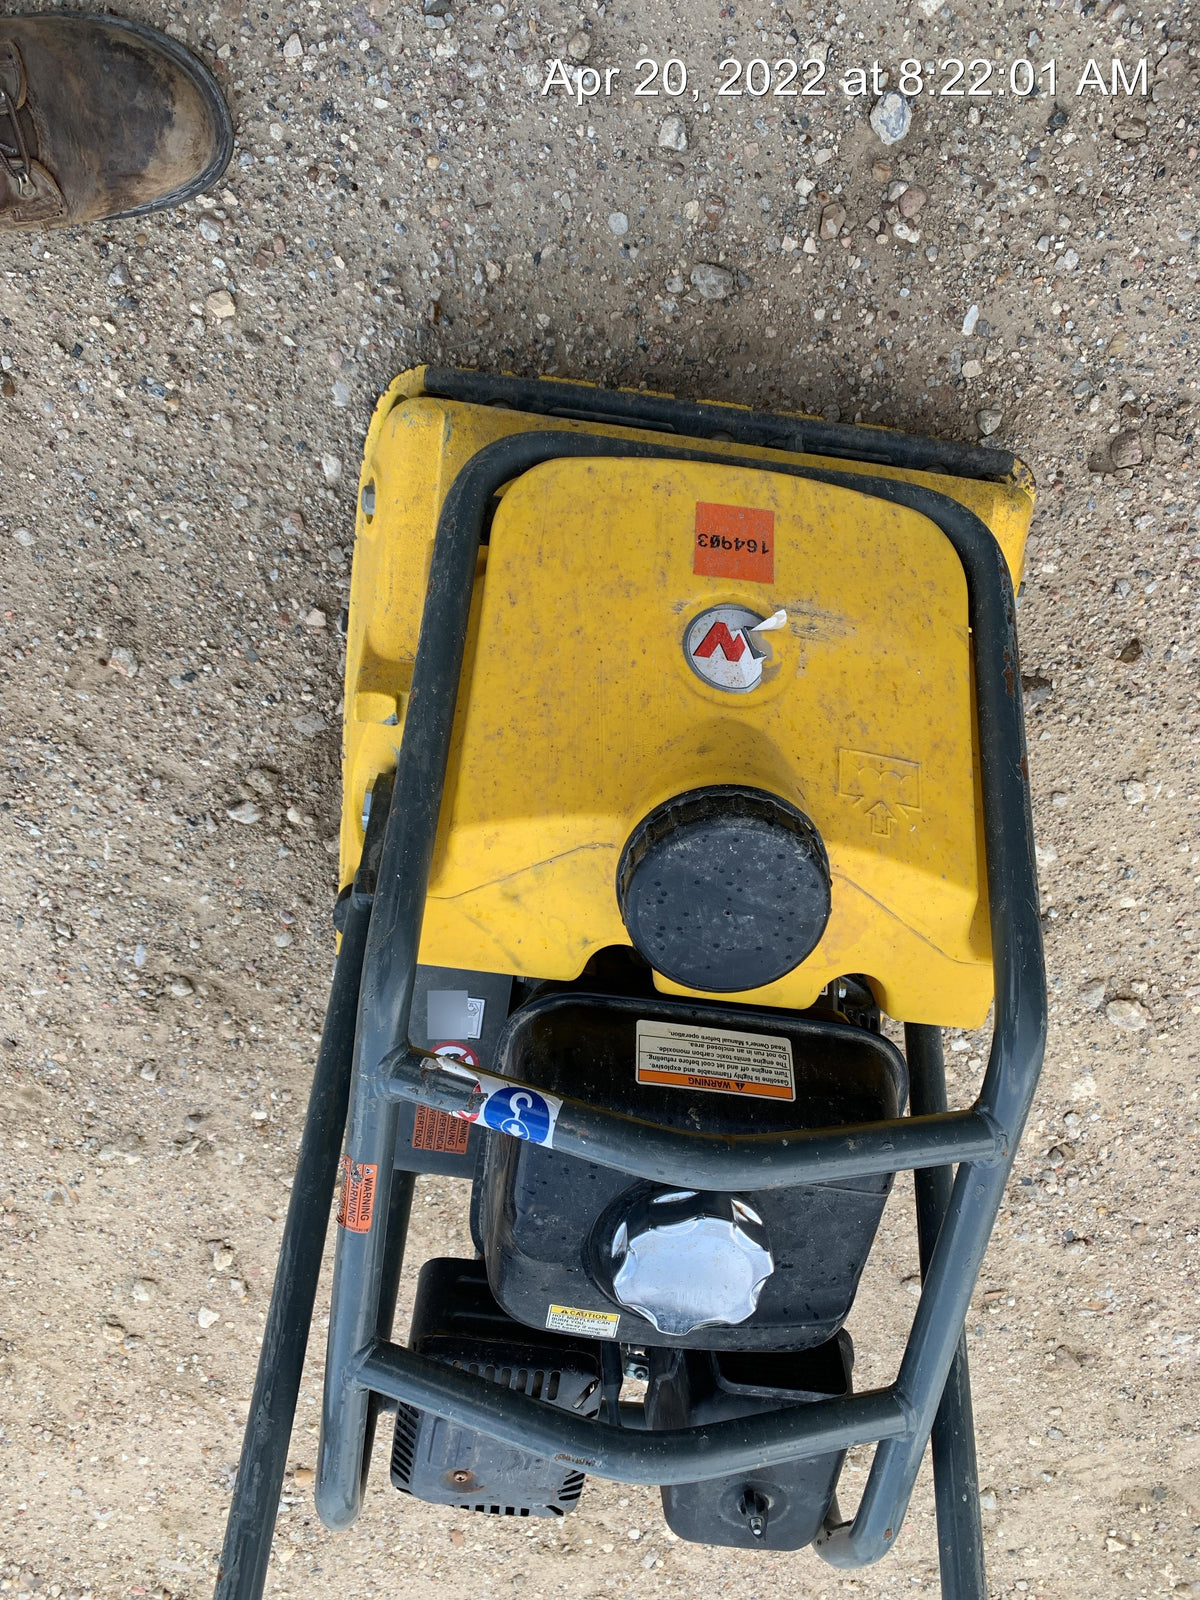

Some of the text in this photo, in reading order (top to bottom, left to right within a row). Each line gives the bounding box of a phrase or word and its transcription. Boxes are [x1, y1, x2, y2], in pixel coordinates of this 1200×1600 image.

[697, 534, 770, 554] 164903
[707, 1044, 735, 1053] enclosed
[746, 1041, 769, 1049] Owner's
[697, 1069, 732, 1078] flammable
[734, 1072, 753, 1080] highly
[688, 1077, 731, 1089] WARNING
[762, 1077, 789, 1086] Gasoline
[436, 1111, 447, 1150] VERTENCIA
[447, 1116, 458, 1146] RNUNG
[458, 1120, 469, 1144] RNING
[348, 1182, 358, 1223] ARNUNG
[360, 1178, 374, 1221] WARNING
[570, 1310, 608, 1320] CAUTION
